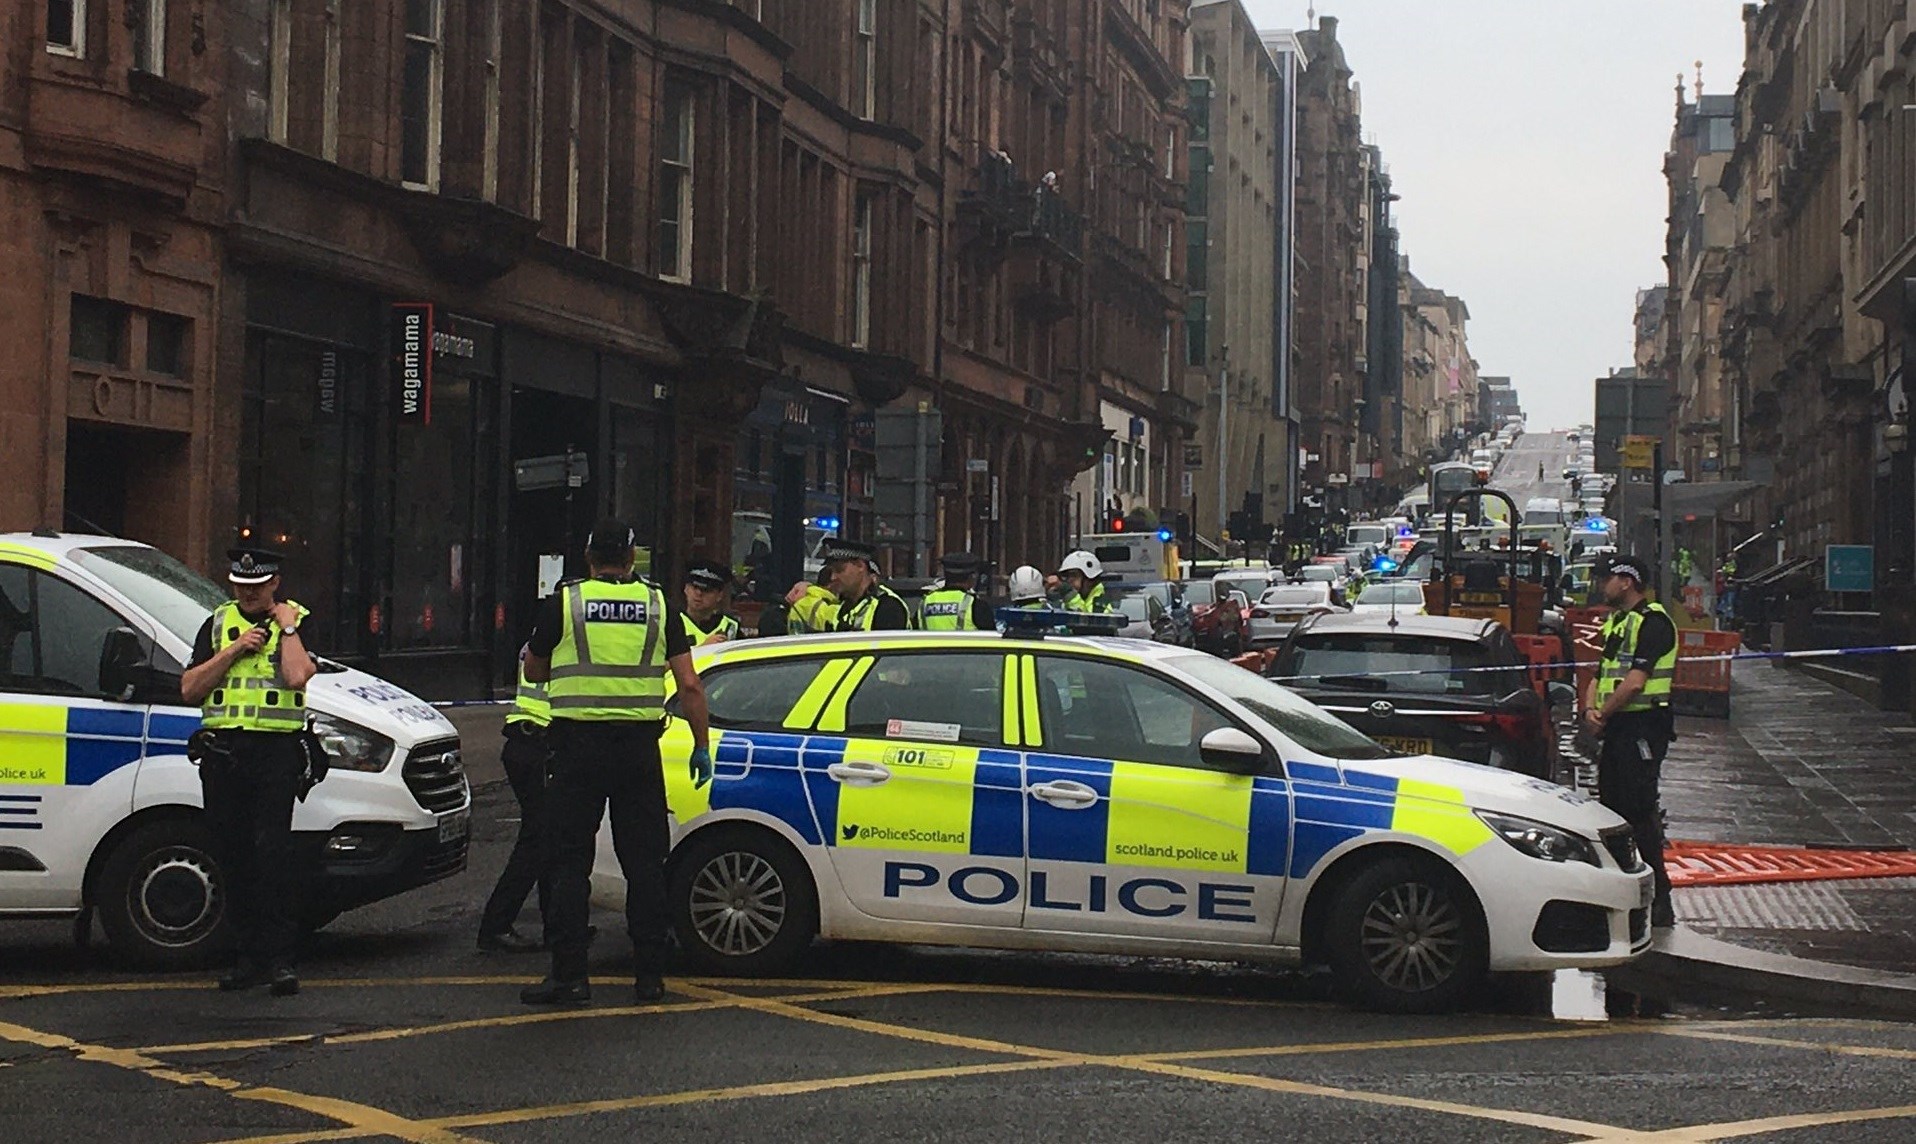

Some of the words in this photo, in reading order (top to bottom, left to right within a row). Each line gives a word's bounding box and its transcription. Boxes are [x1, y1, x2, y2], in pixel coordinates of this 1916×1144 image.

[432, 331, 474, 358] agamama
[403, 314, 422, 414] wagamama
[586, 601, 645, 621] POLICE
[925, 603, 957, 615] POLICE
[897, 749, 926, 765] 101
[860, 825, 965, 844] @PoliceScotland
[883, 861, 1257, 923] POLICE
